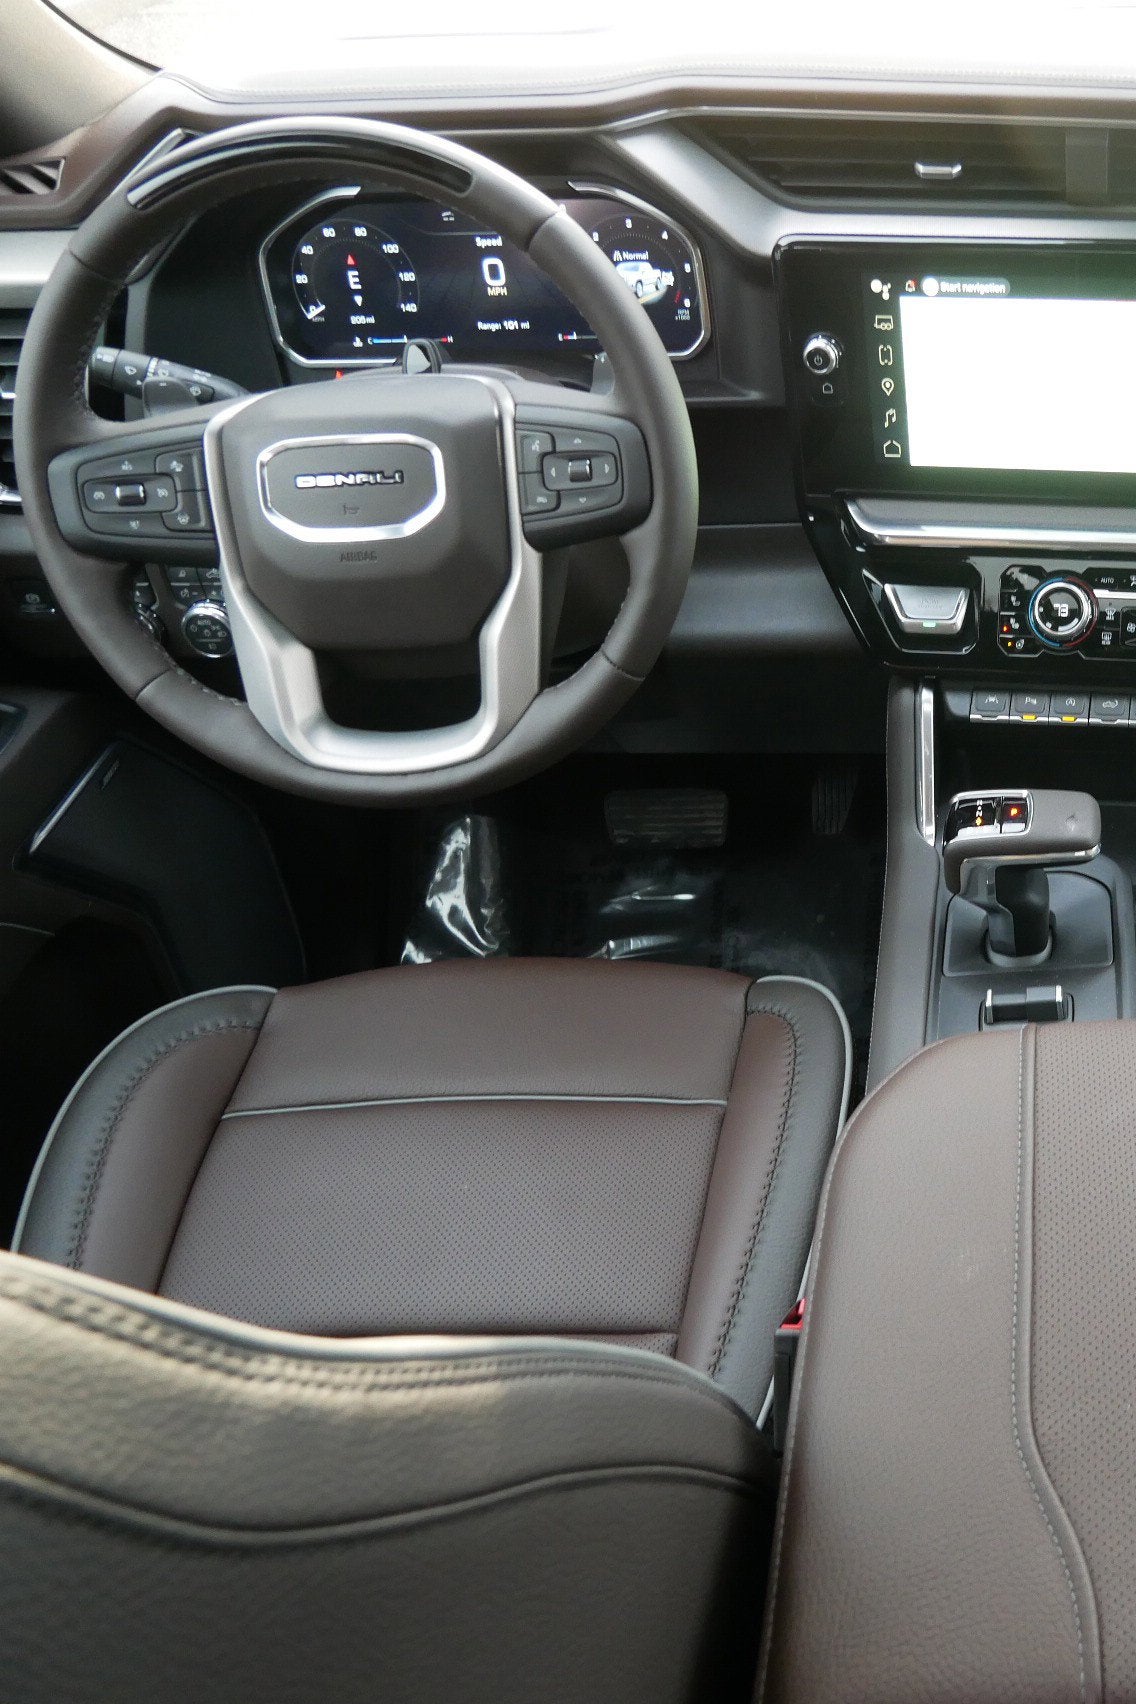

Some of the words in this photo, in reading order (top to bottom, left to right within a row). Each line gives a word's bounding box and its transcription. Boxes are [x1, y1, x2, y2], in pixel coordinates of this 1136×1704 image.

[661, 230, 669, 240] 4
[475, 236, 503, 249] Speed
[301, 245, 314, 255] 40
[382, 243, 399, 254] 100
[622, 250, 649, 261] Normal
[481, 257, 507, 287] 0
[346, 270, 362, 290] E
[487, 286, 508, 297] MPH
[940, 281, 961, 293] Start
[962, 282, 1006, 295] navigation
[400, 303, 418, 313] 140
[295, 470, 404, 489] DENALI
[339, 551, 378, 562] AIRBAG
